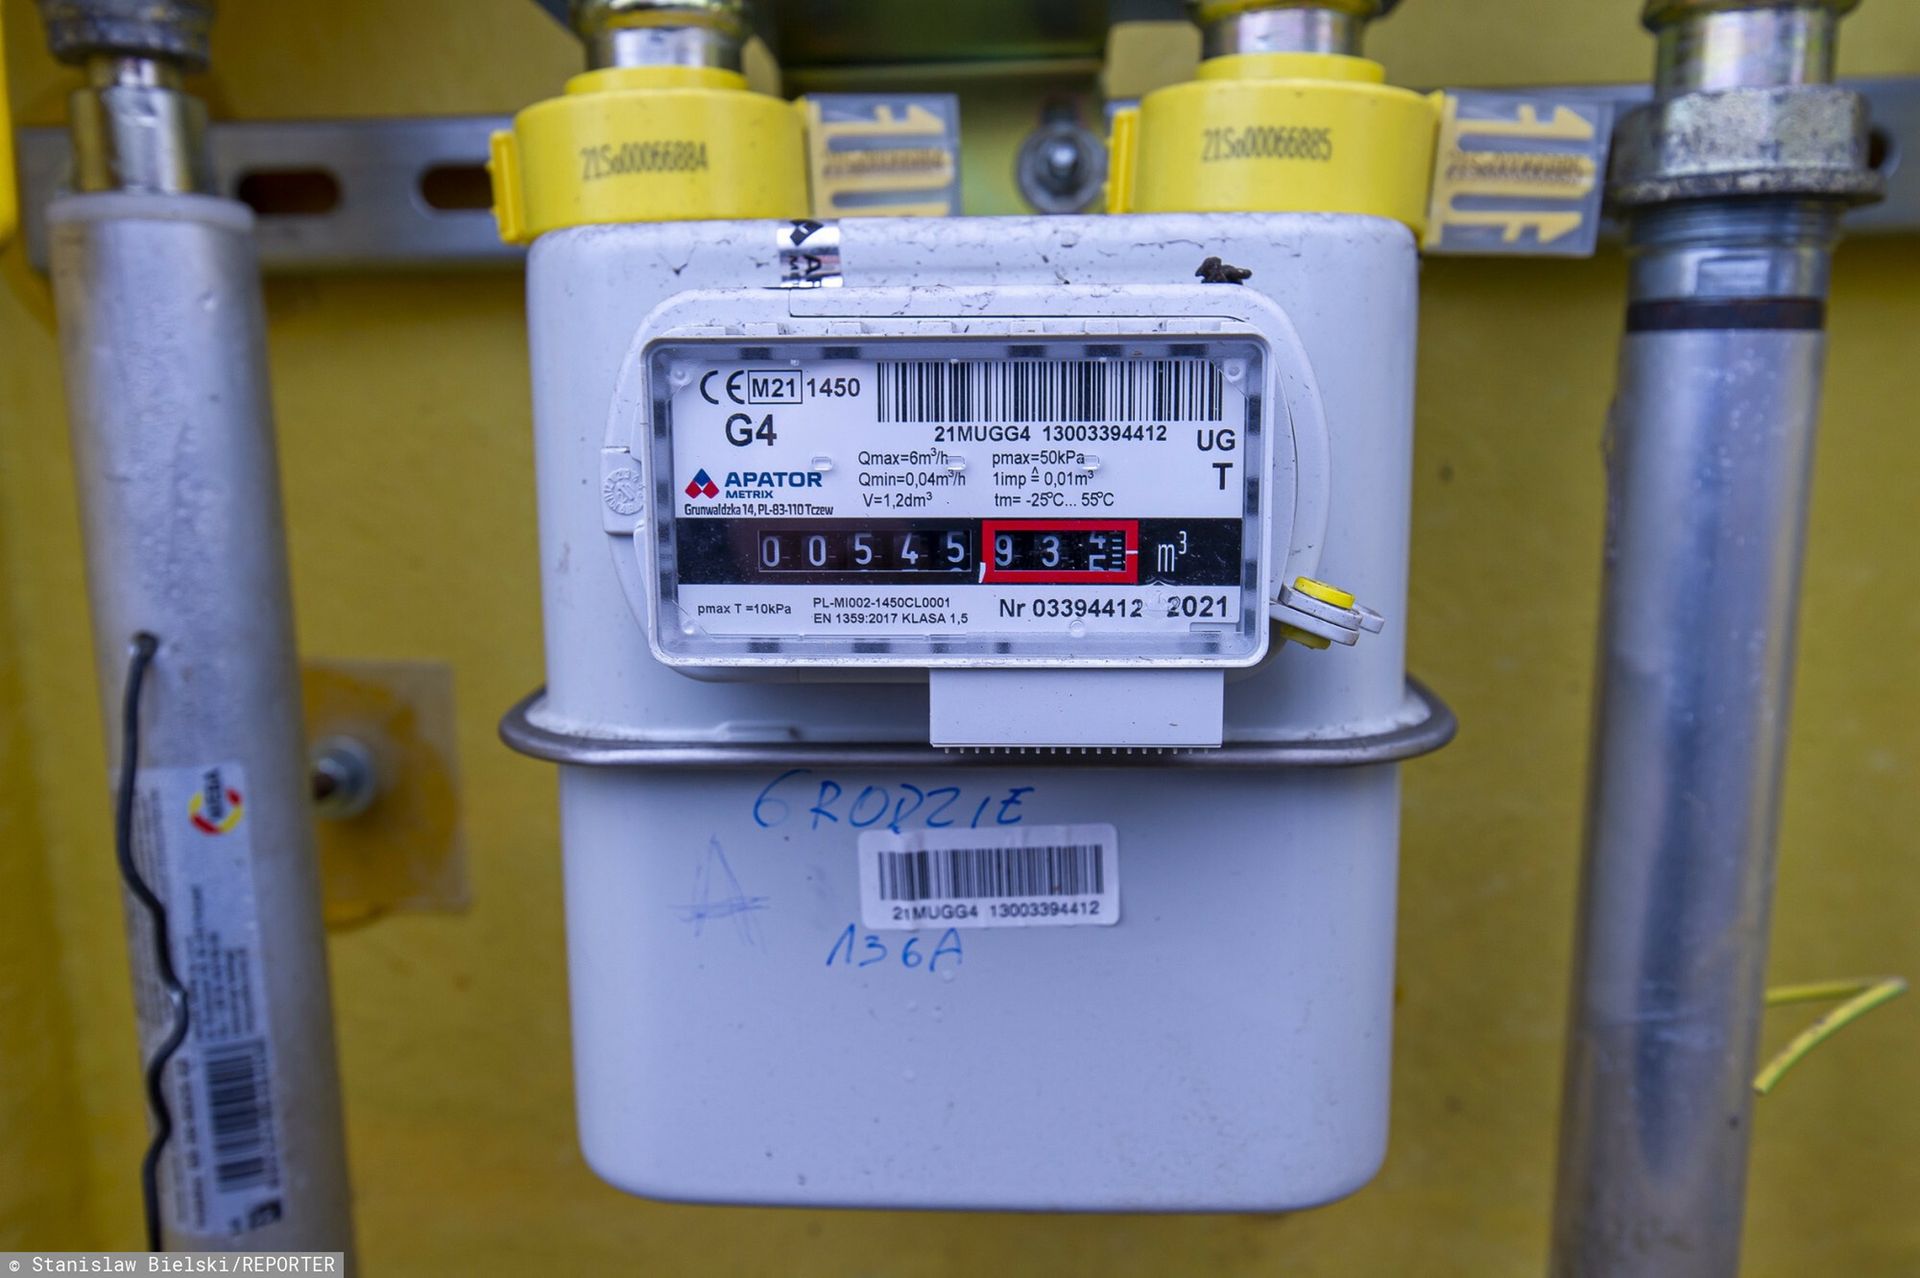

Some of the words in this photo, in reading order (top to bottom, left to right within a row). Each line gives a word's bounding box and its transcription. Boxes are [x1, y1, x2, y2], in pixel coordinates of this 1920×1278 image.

[752, 378, 795, 398] M21
[807, 378, 861, 397] 1450
[725, 413, 777, 447] G4
[934, 426, 1031, 442] 21MUGG4
[1043, 425, 1167, 442] 13003394412
[1197, 429, 1236, 451] UG
[992, 450, 1085, 466] pmax=50kPa
[724, 472, 823, 488] APATOR
[1212, 463, 1233, 490] T
[725, 490, 774, 499] METRIX
[994, 493, 1021, 507] tm=
[684, 503, 741, 516] Grunwaldzka
[743, 504, 757, 516] 14,
[758, 504, 803, 515] PL-83-110
[806, 504, 833, 516] Tczew
[697, 605, 731, 616] pmax
[734, 604, 742, 614] T
[745, 603, 792, 615] =10kPa
[813, 597, 950, 609] PL-MI002-1450CL0001
[1000, 599, 1026, 617] Nr
[1032, 599, 1143, 617] 03394412
[1166, 596, 1227, 616] 2021
[813, 613, 833, 624] EN
[836, 612, 897, 624] 1359:2017
[901, 612, 946, 624] KLASA
[949, 613, 969, 625] 1,5
[892, 905, 979, 922] 21MUGG4
[990, 901, 1100, 919] 13003394412
